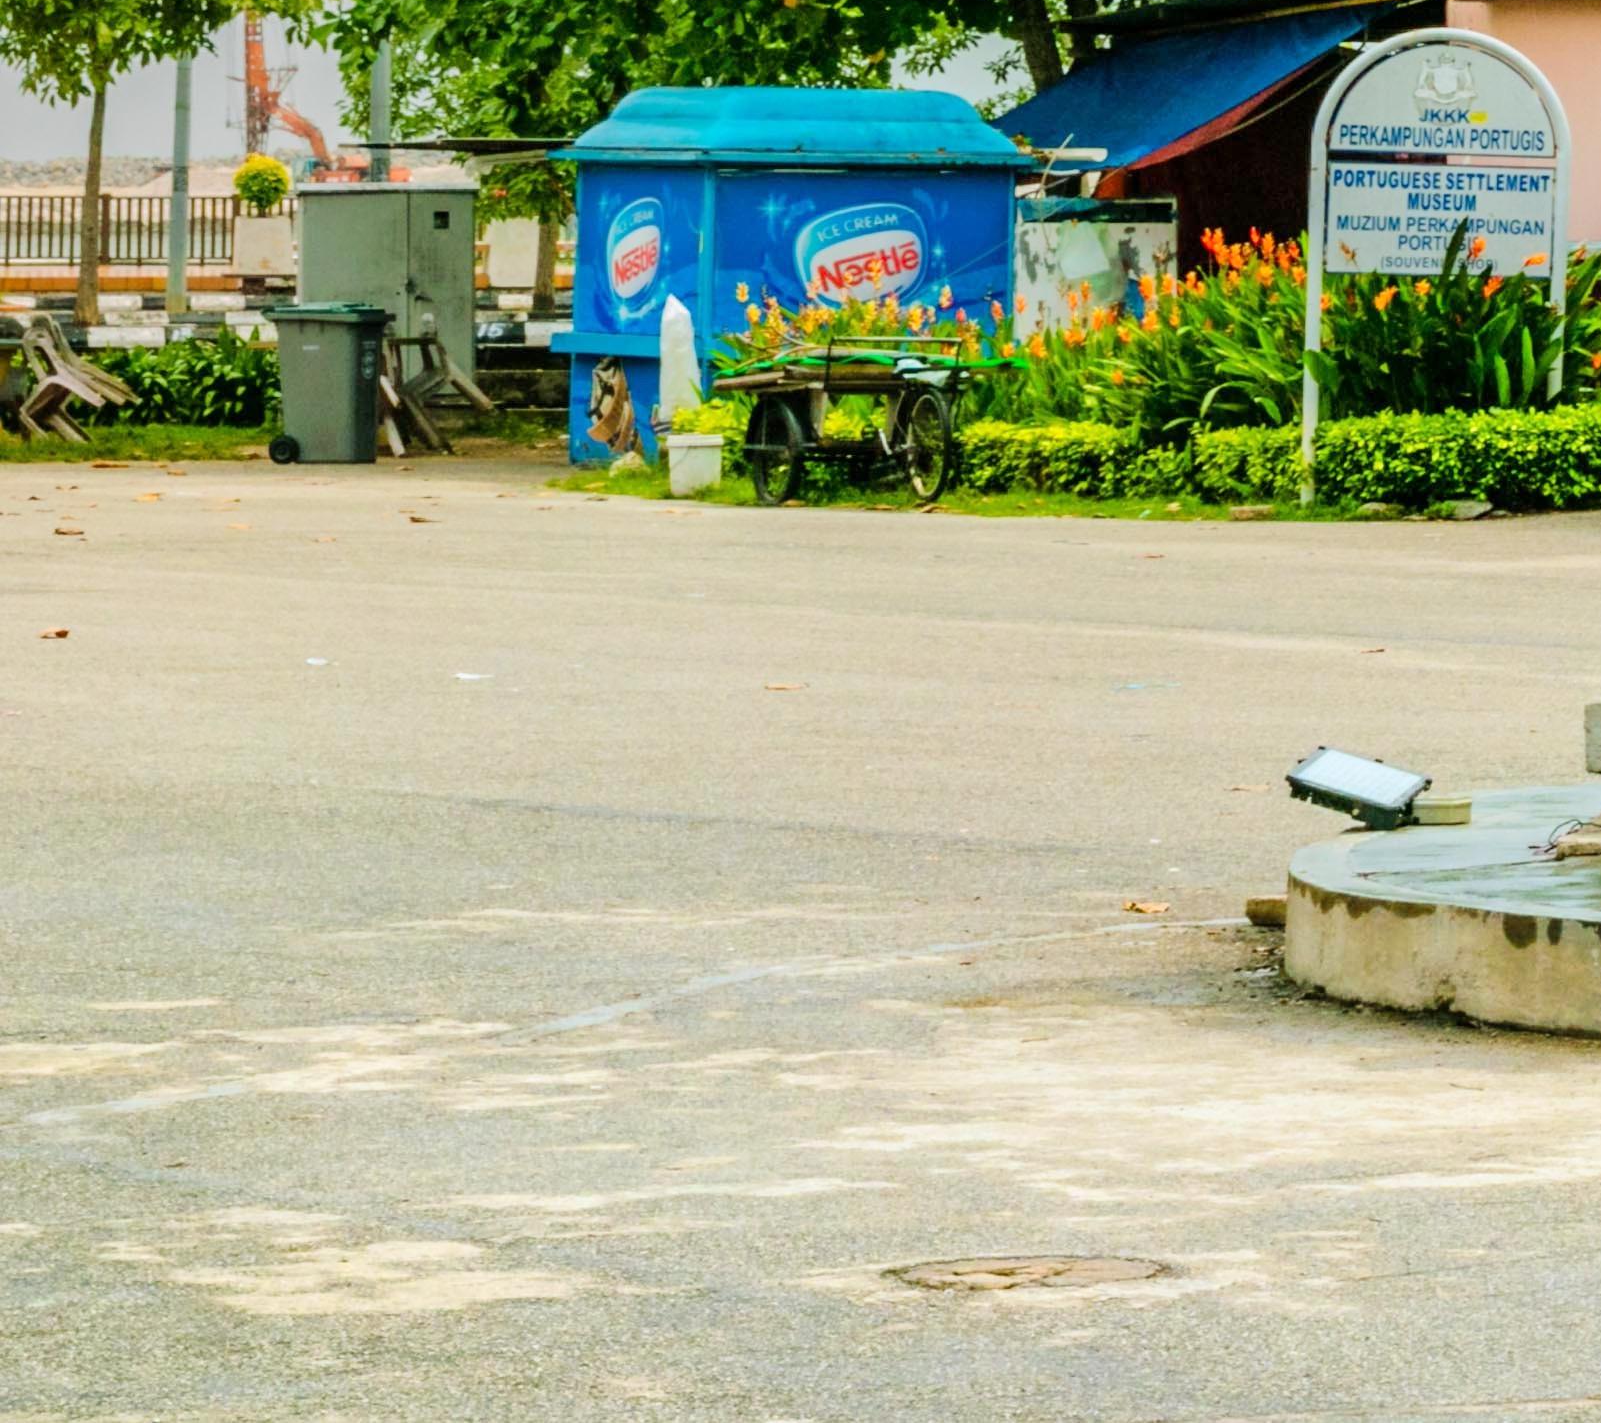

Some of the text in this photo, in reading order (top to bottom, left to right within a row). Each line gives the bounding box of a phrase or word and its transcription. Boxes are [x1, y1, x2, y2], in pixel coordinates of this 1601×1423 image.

[1419, 108, 1469, 123] JKKK
[1339, 124, 1545, 151] PERKAMPUNGAN PORTUGIS
[1333, 169, 1550, 192] PORTUGUESE SETTLEMENT
[1407, 192, 1477, 211] MUSEUM
[817, 214, 899, 242] ICE CREAM
[1336, 216, 1400, 231] MUZIUM
